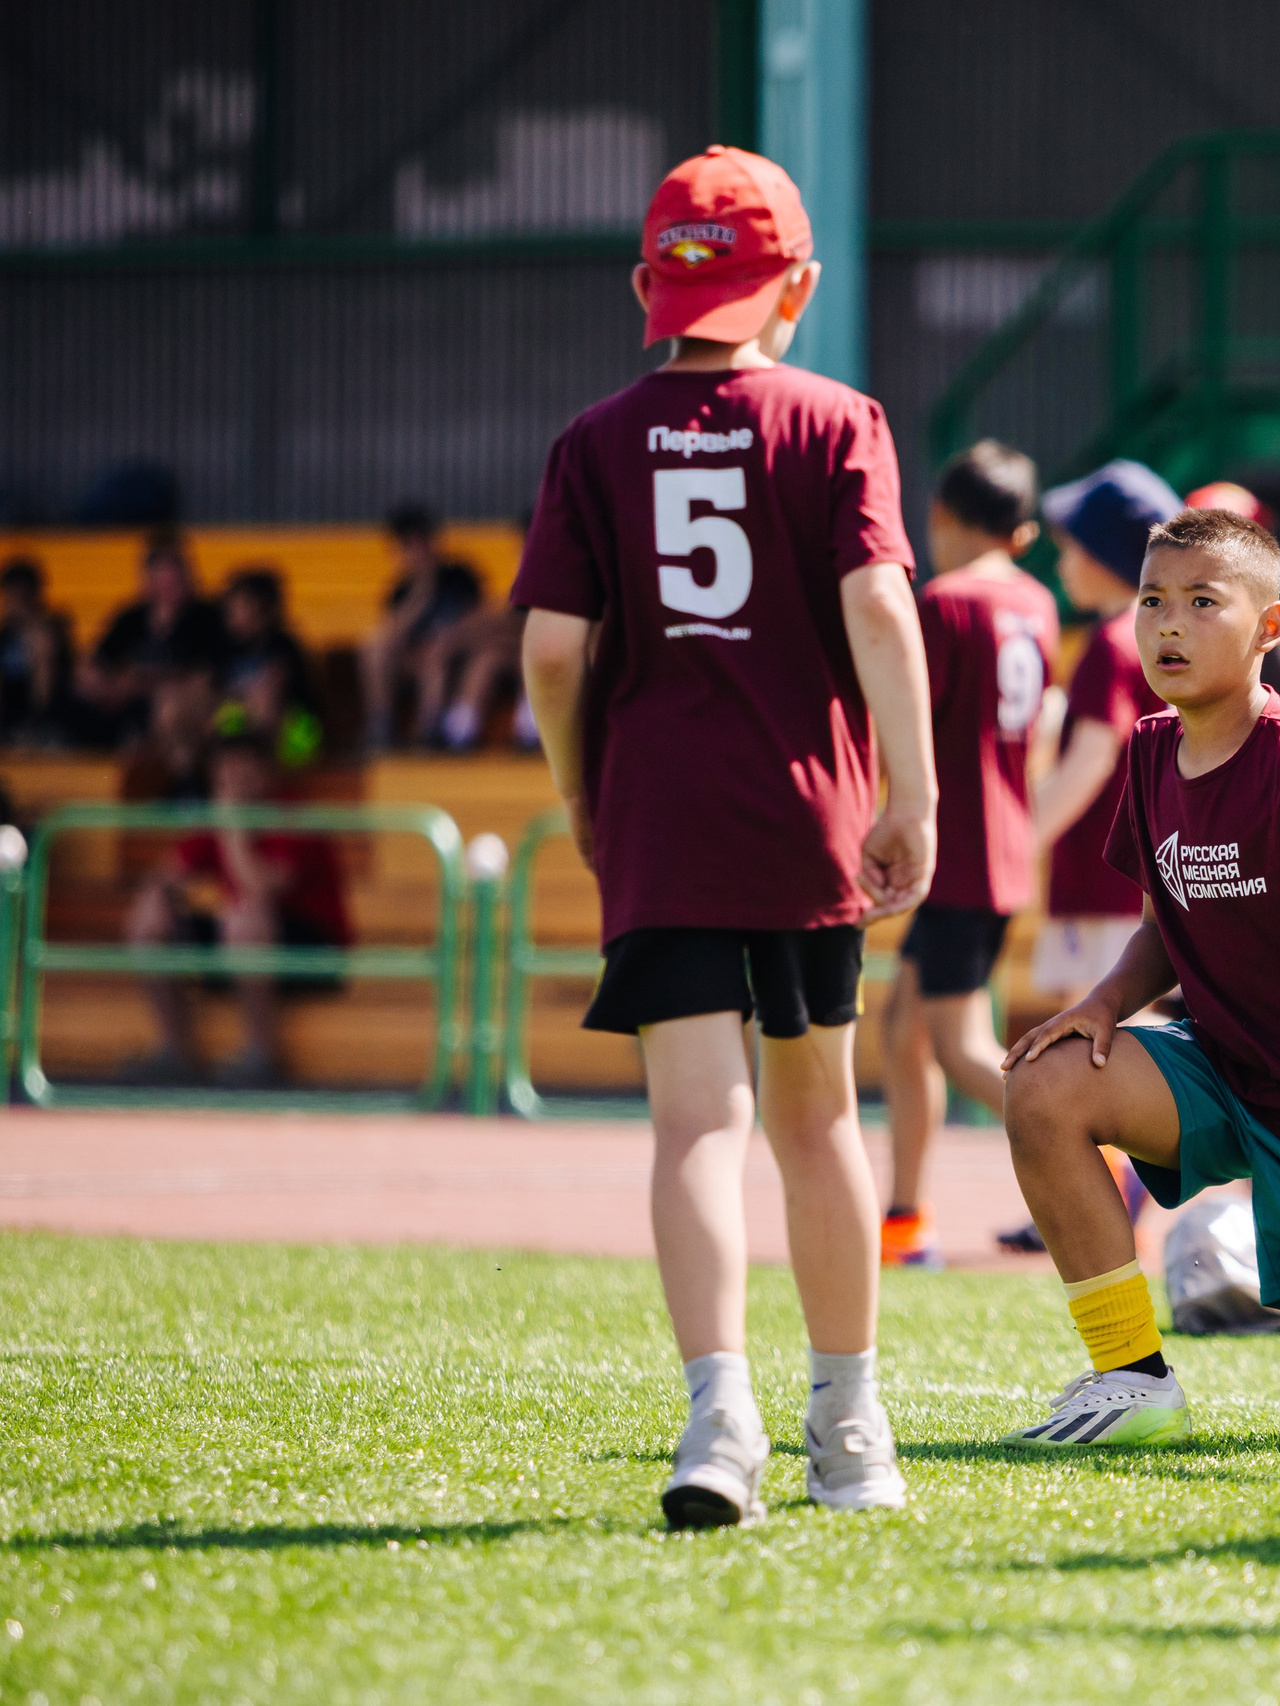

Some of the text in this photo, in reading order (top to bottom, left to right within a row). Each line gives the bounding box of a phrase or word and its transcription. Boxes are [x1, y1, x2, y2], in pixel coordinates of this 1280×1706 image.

[648, 425, 753, 459] Первые
[653, 467, 753, 620] 5
[1180, 842, 1240, 862] РУССКАЯ
[1182, 862, 1241, 881] МЕДНАЯ
[1186, 877, 1268, 899] КОМПАНИЯ
